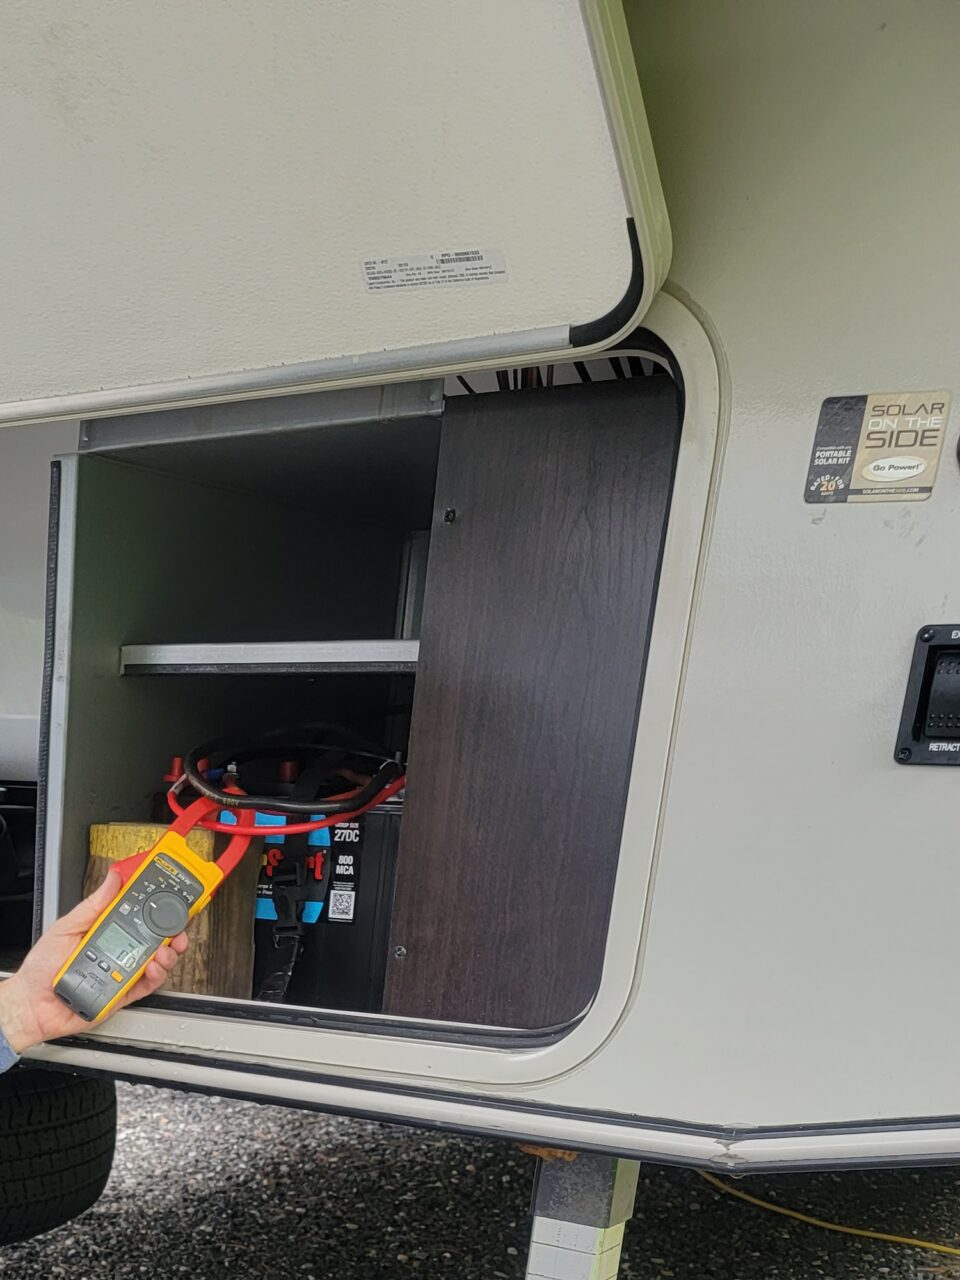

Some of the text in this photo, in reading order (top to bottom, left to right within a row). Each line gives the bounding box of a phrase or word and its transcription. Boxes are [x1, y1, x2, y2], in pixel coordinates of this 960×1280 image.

[870, 402, 945, 418] SOLAR
[868, 416, 943, 430] ON THE
[865, 429, 941, 449] SIDE
[815, 450, 852, 458] PORTABLE
[814, 457, 851, 466] SOLAR KIT
[872, 462, 920, 472] Go Power!
[820, 480, 837, 492] 20
[928, 742, 960, 752] RETRACT
[334, 829, 360, 842] 27DC
[335, 865, 354, 875] MCA
